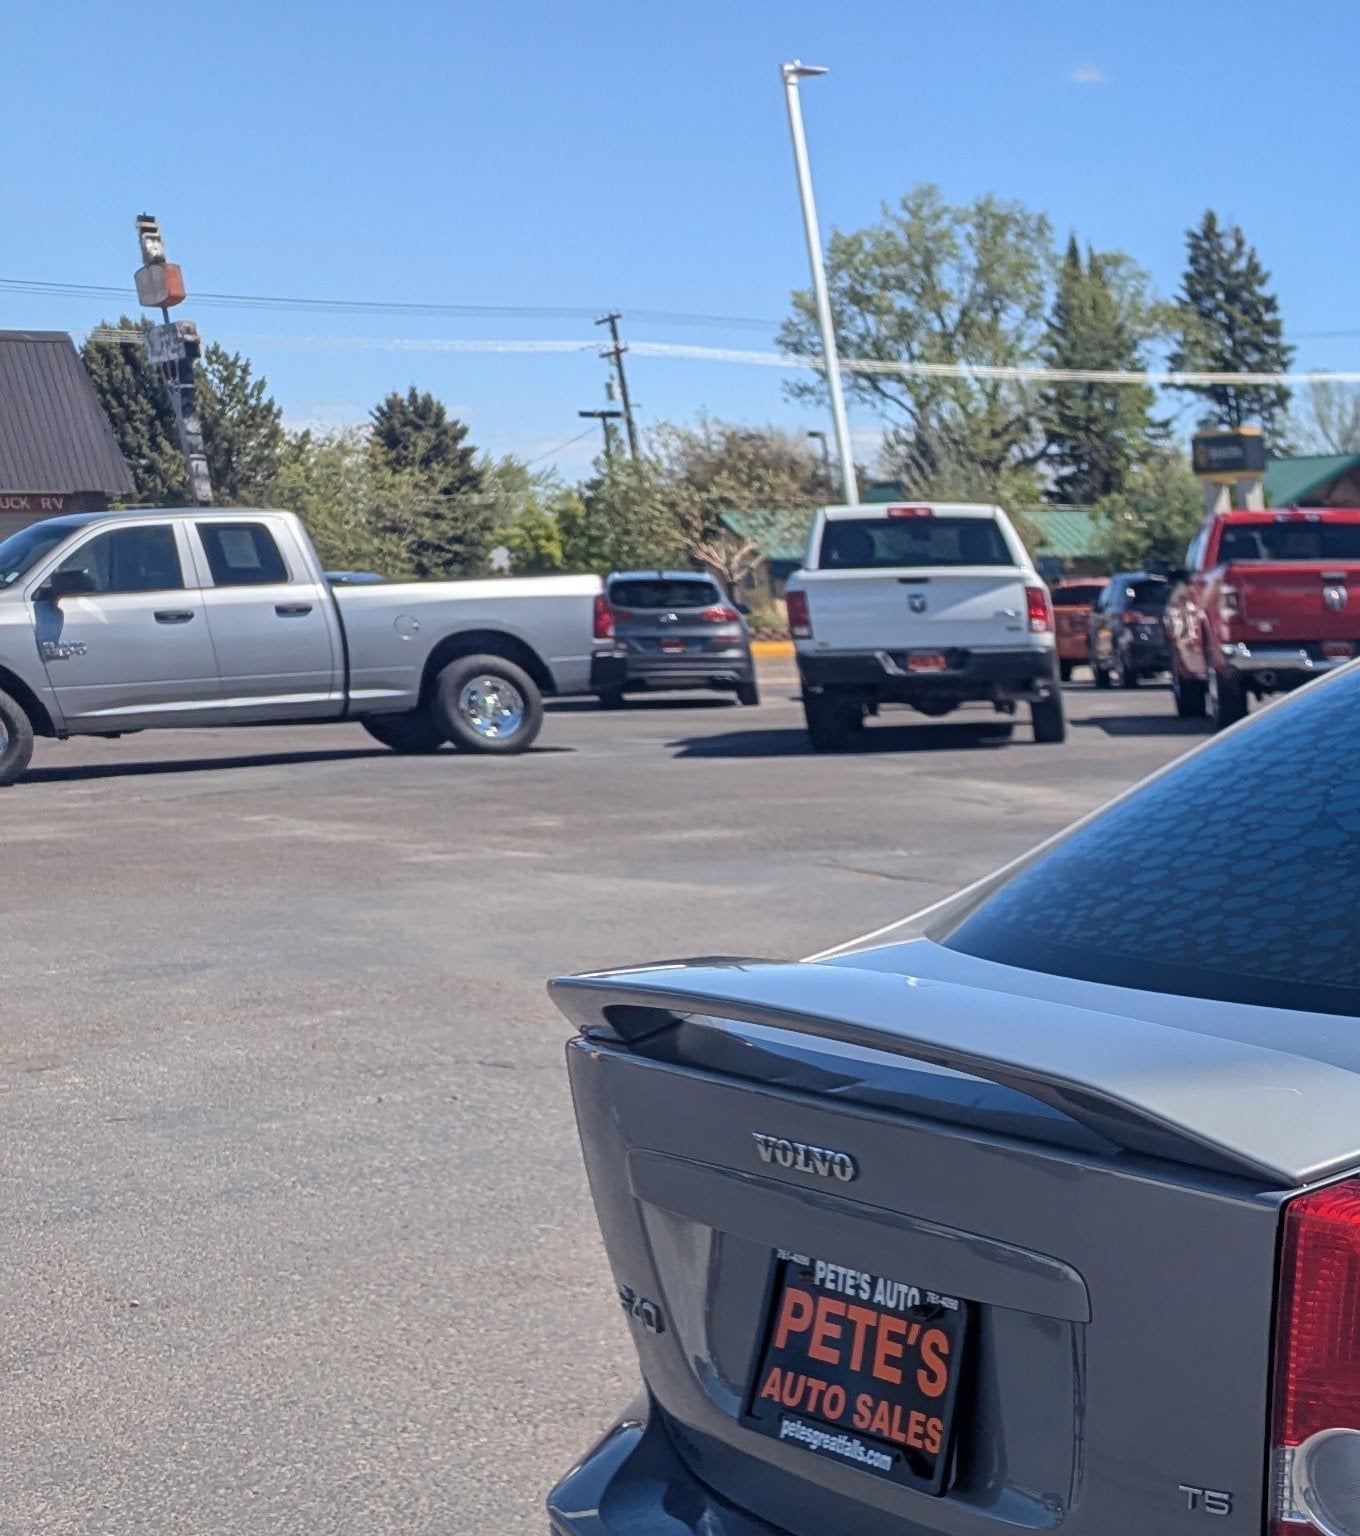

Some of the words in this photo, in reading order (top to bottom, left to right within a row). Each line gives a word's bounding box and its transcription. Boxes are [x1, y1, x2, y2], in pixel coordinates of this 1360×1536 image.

[41, 496, 64, 510] RV
[752, 1131, 855, 1182] VOLVO
[813, 1259, 871, 1301] PETE'S
[873, 1277, 920, 1312] AUTO
[774, 1286, 950, 1398] PETE'S
[761, 1367, 846, 1420] AUTO
[852, 1393, 945, 1455] SALES
[780, 1419, 893, 1471] petesgreatfalls.com
[1178, 1484, 1230, 1515] T5
